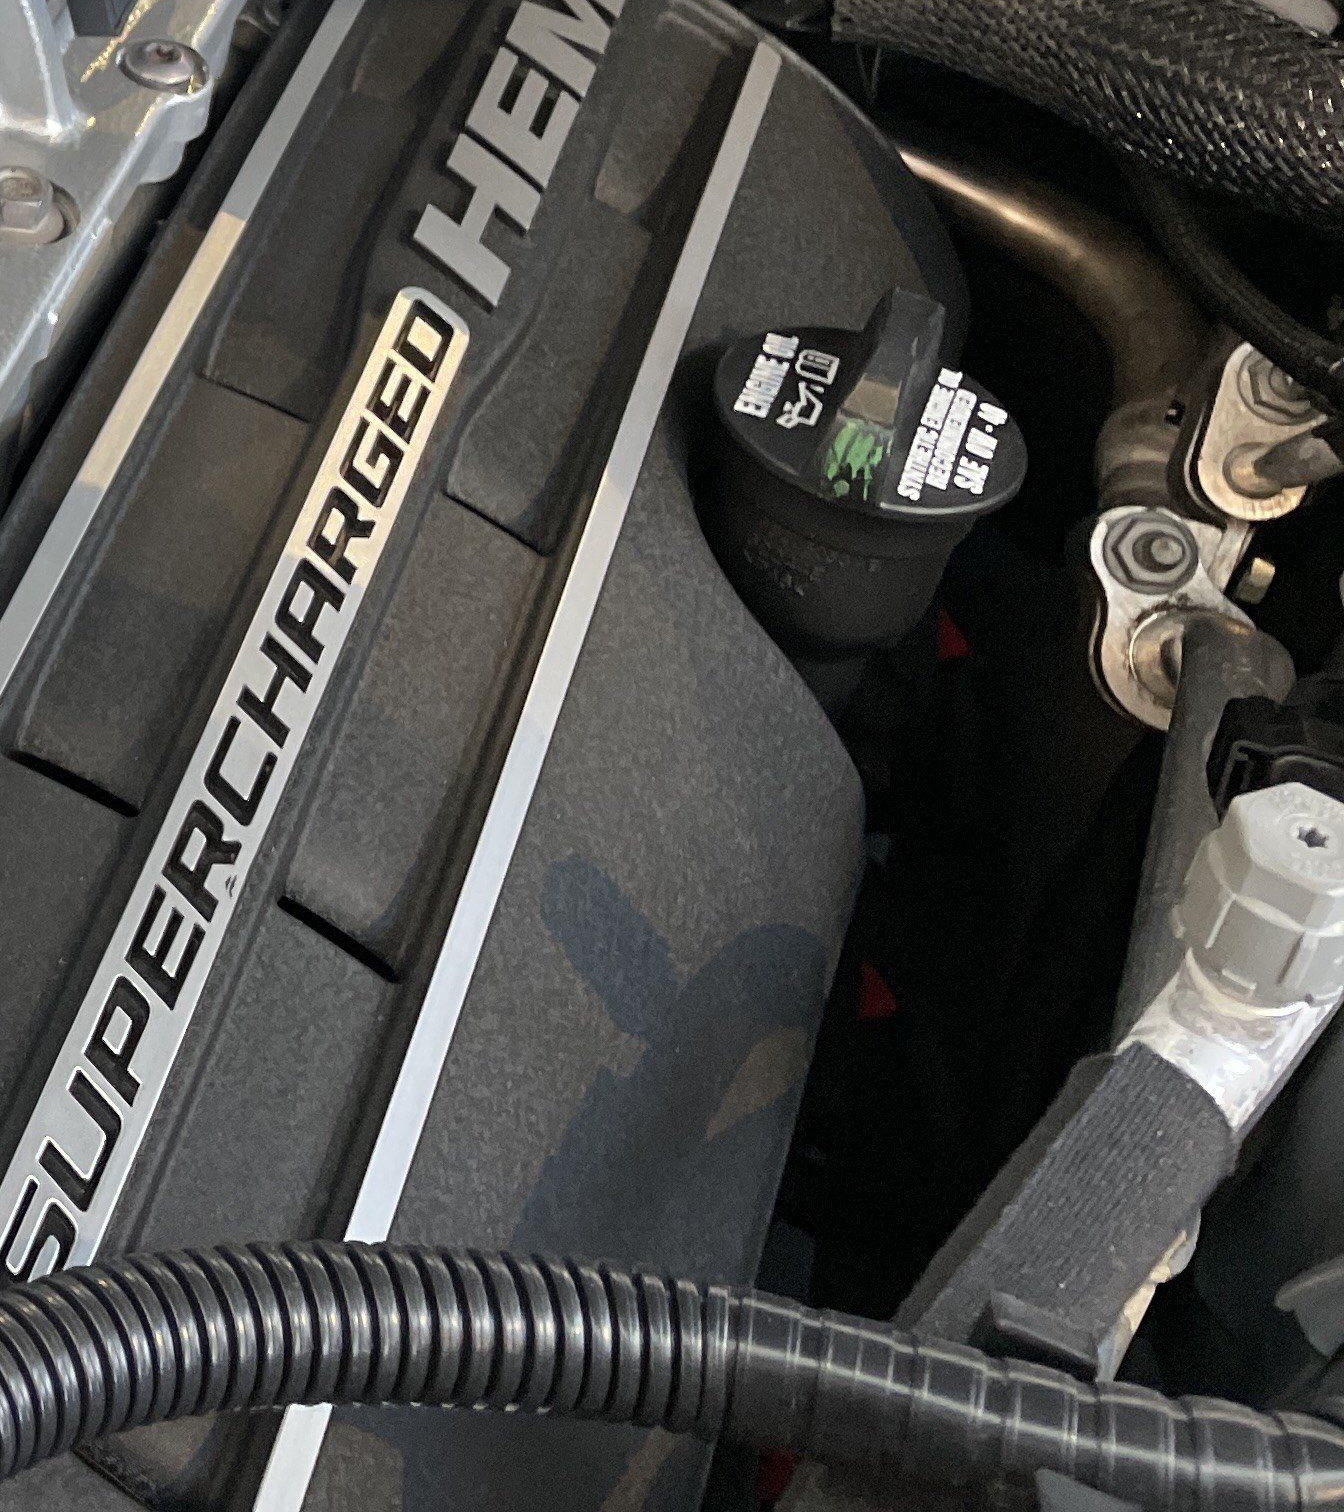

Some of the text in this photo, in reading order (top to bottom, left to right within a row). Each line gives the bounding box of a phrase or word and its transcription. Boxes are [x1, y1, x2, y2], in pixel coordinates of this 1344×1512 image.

[733, 332, 799, 418] ENGINE OIL
[897, 367, 963, 501] SYNTHETIC ENGINE OIL
[925, 388, 978, 491] RECOMMENDED
[953, 455, 989, 494] SAE
